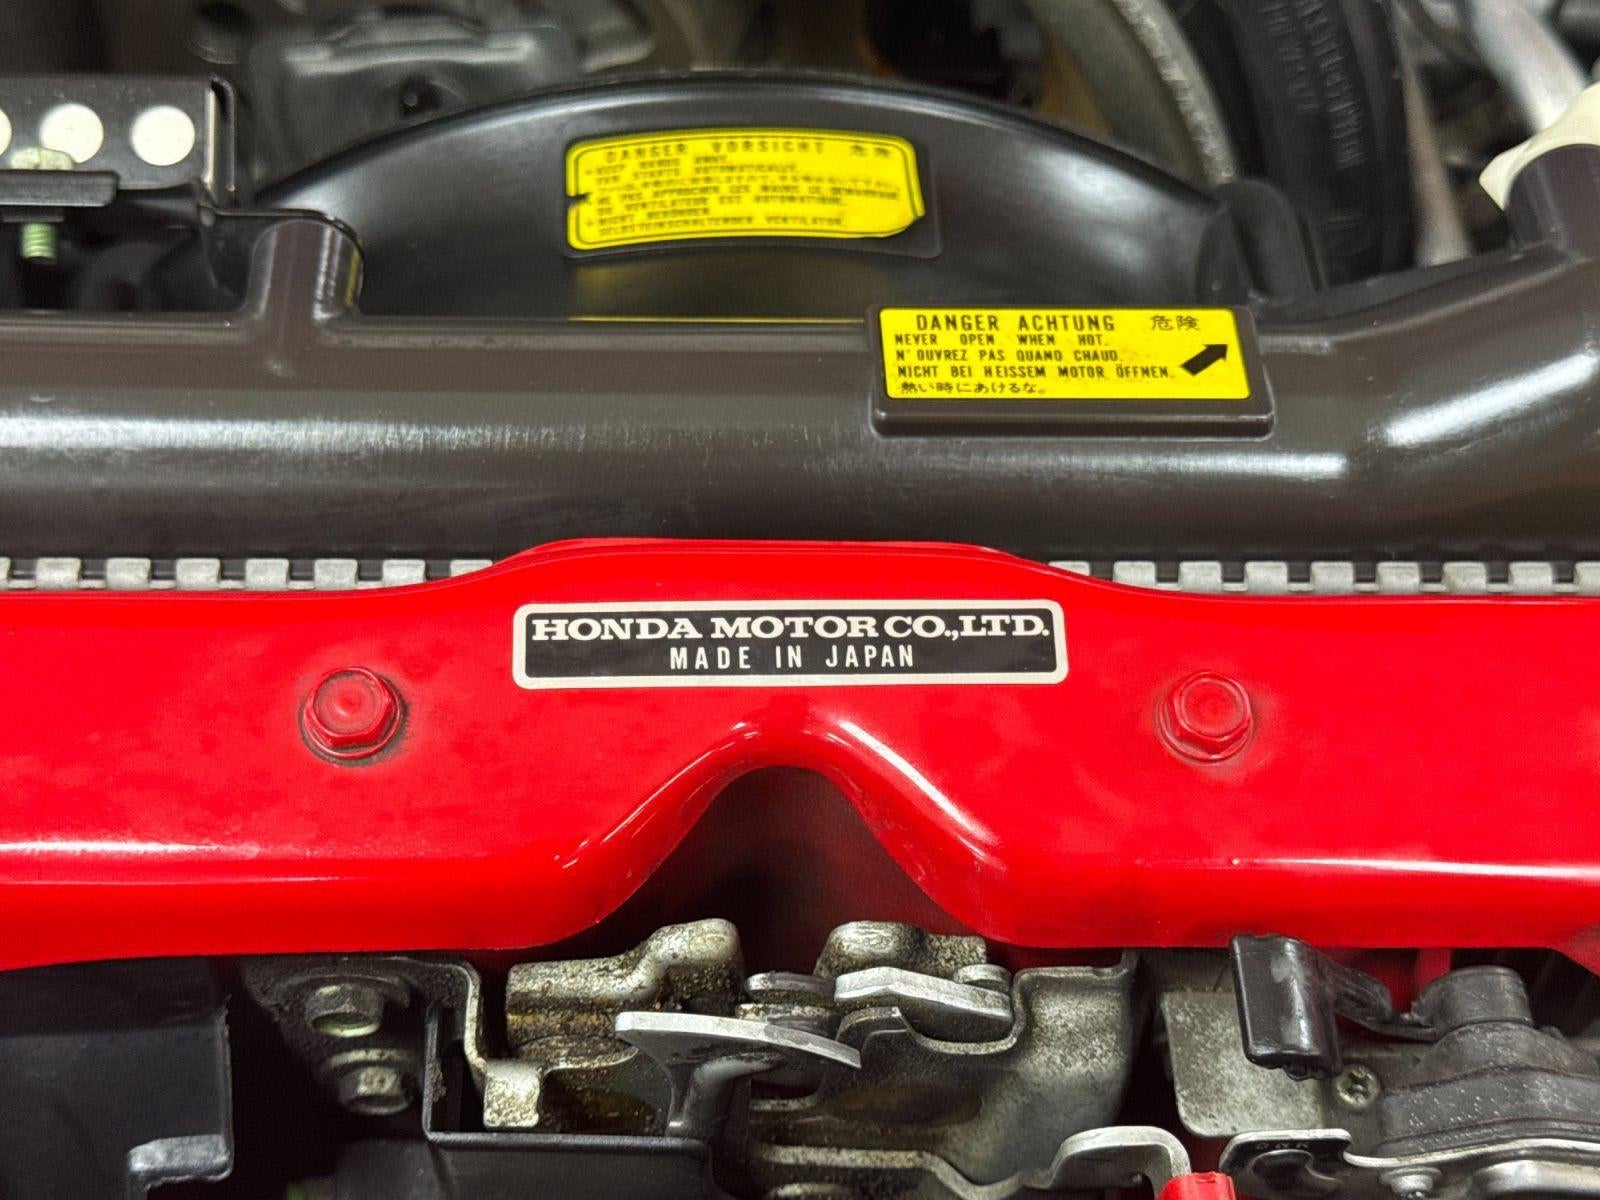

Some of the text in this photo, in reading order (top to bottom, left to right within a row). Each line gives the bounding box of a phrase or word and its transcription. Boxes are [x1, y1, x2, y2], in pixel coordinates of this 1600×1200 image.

[605, 143, 687, 163] DANGER
[712, 140, 824, 154] VORSICHT
[916, 314, 1115, 331] DANGER ACHTUNG
[1150, 315, 1199, 331] 危険
[895, 334, 938, 346] NEVER
[960, 334, 995, 346] OPEN
[1017, 334, 1056, 346] WHEN
[979, 350, 1005, 361] PAS
[1016, 350, 1063, 361] QUAND
[897, 366, 938, 378] NICHT
[950, 366, 972, 378] BEI
[984, 366, 1046, 378] HEISSEM
[1058, 366, 1104, 378] MOTOR
[531, 617, 703, 641] HONDA
[710, 615, 879, 639] MOTOR
[670, 644, 914, 669] MADE IN JAPAN
